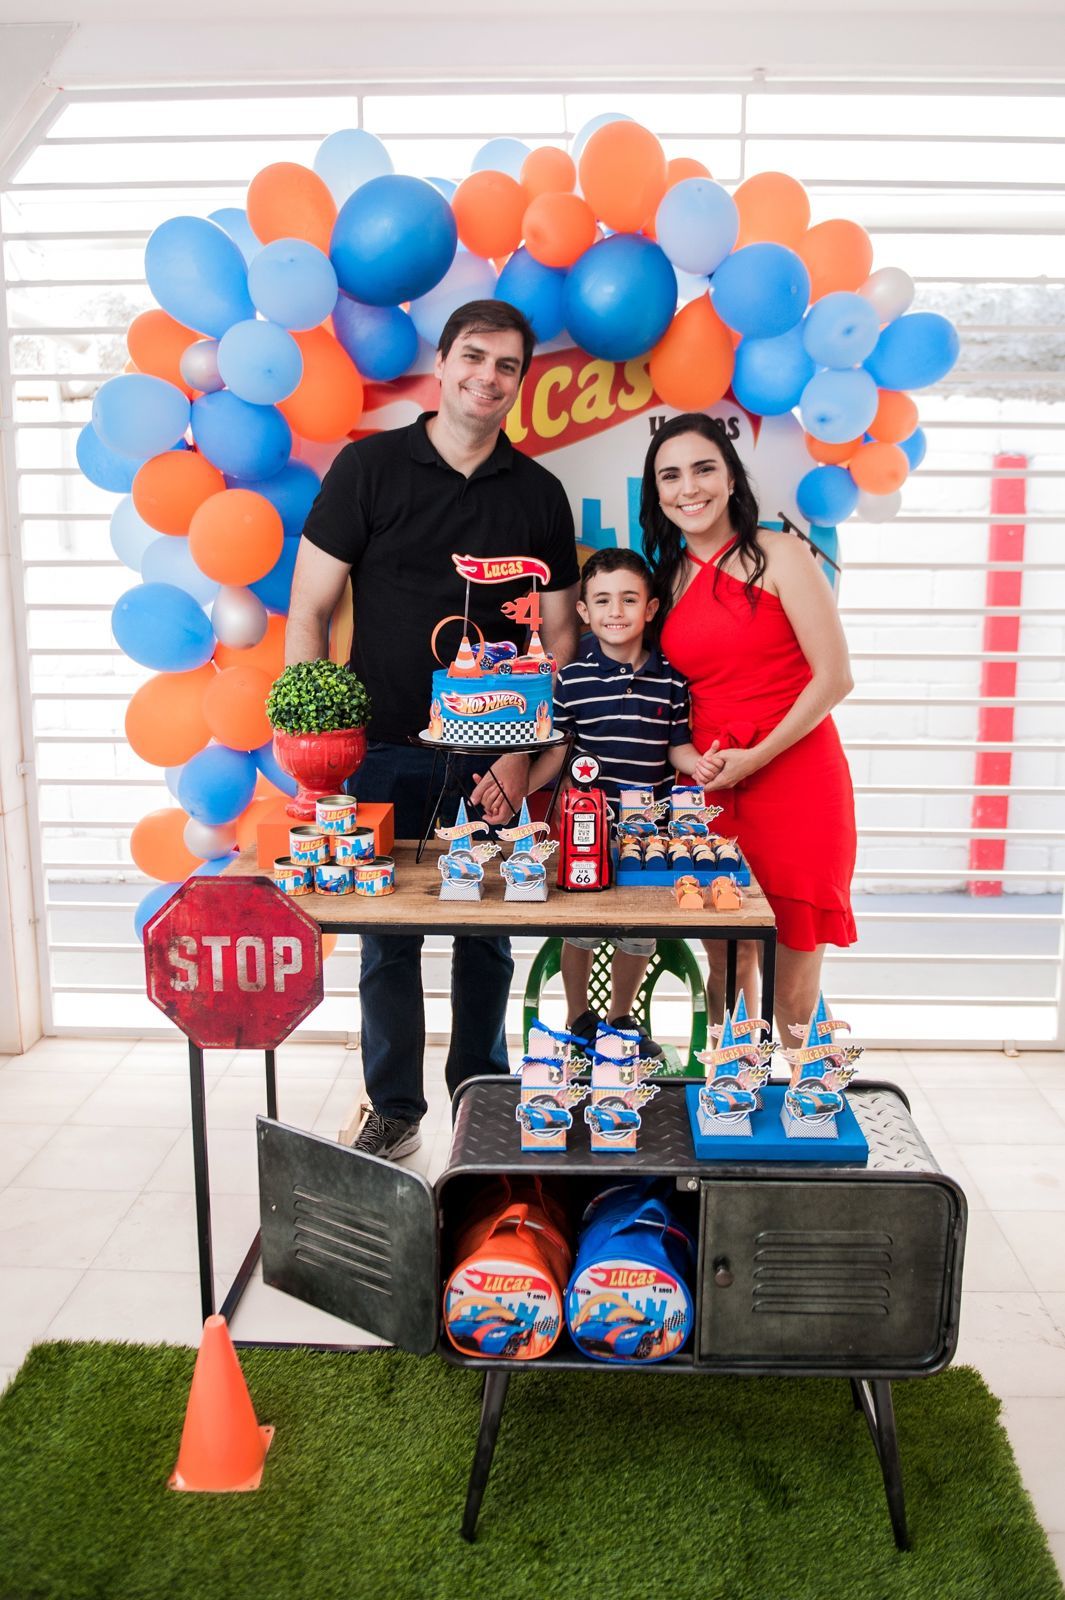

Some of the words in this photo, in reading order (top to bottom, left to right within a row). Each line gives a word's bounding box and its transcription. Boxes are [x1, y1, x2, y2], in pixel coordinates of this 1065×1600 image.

[482, 560, 524, 579] Lucas
[516, 592, 543, 631] 4
[575, 874, 591, 884] 66
[168, 936, 302, 992] STOP
